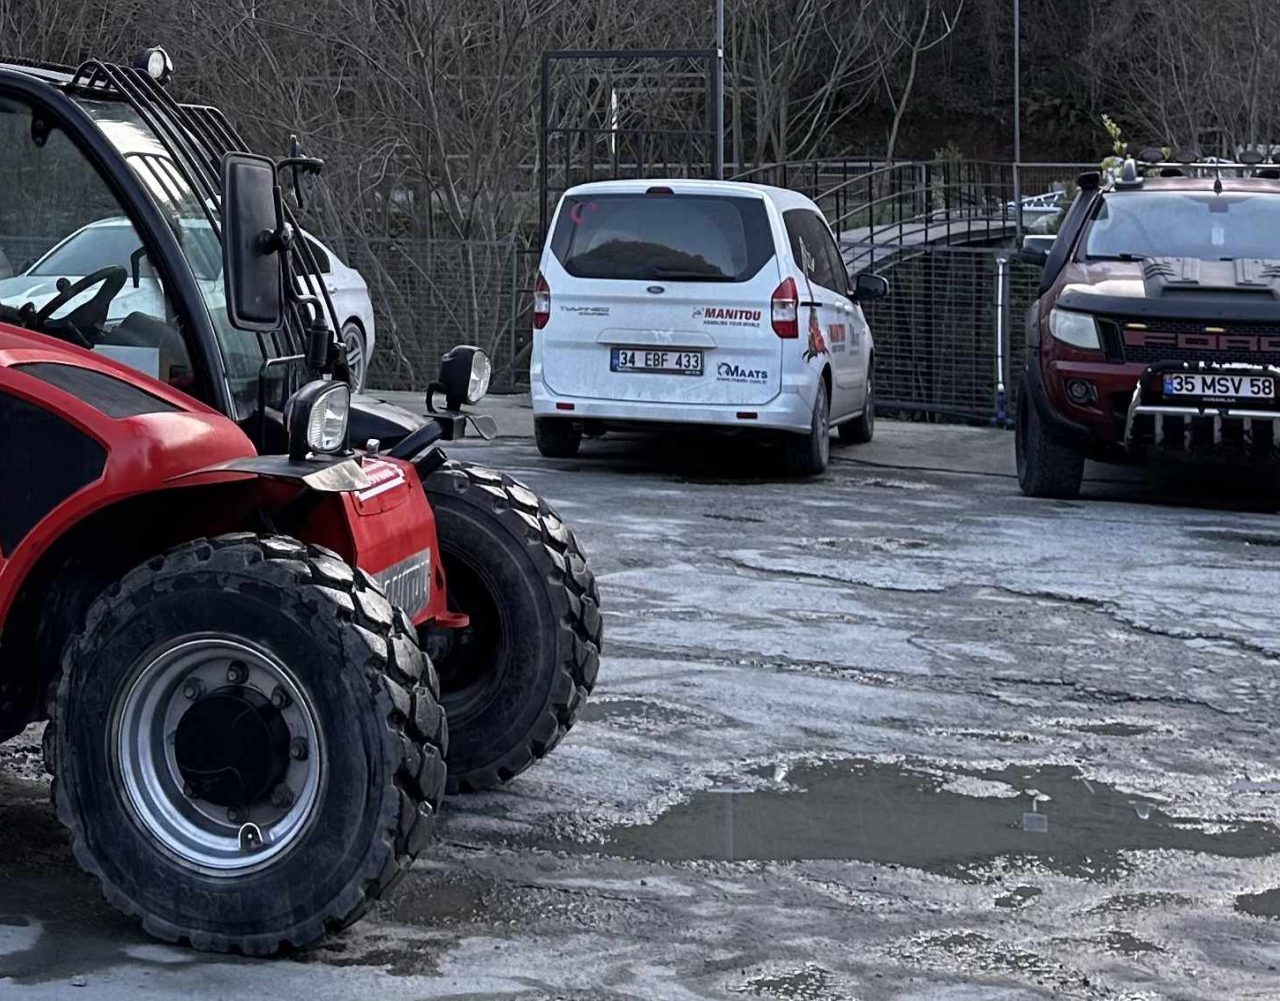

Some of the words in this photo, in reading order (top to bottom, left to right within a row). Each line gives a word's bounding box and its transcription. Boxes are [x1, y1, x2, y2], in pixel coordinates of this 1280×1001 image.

[704, 307, 761, 321] MANITOU
[621, 352, 635, 367] 34
[645, 352, 669, 367] EBF
[675, 353, 699, 369] 433
[726, 365, 768, 379] MAATS
[1173, 375, 1195, 392] 35
[1201, 376, 1243, 394] MSV
[1249, 378, 1272, 396] 58
